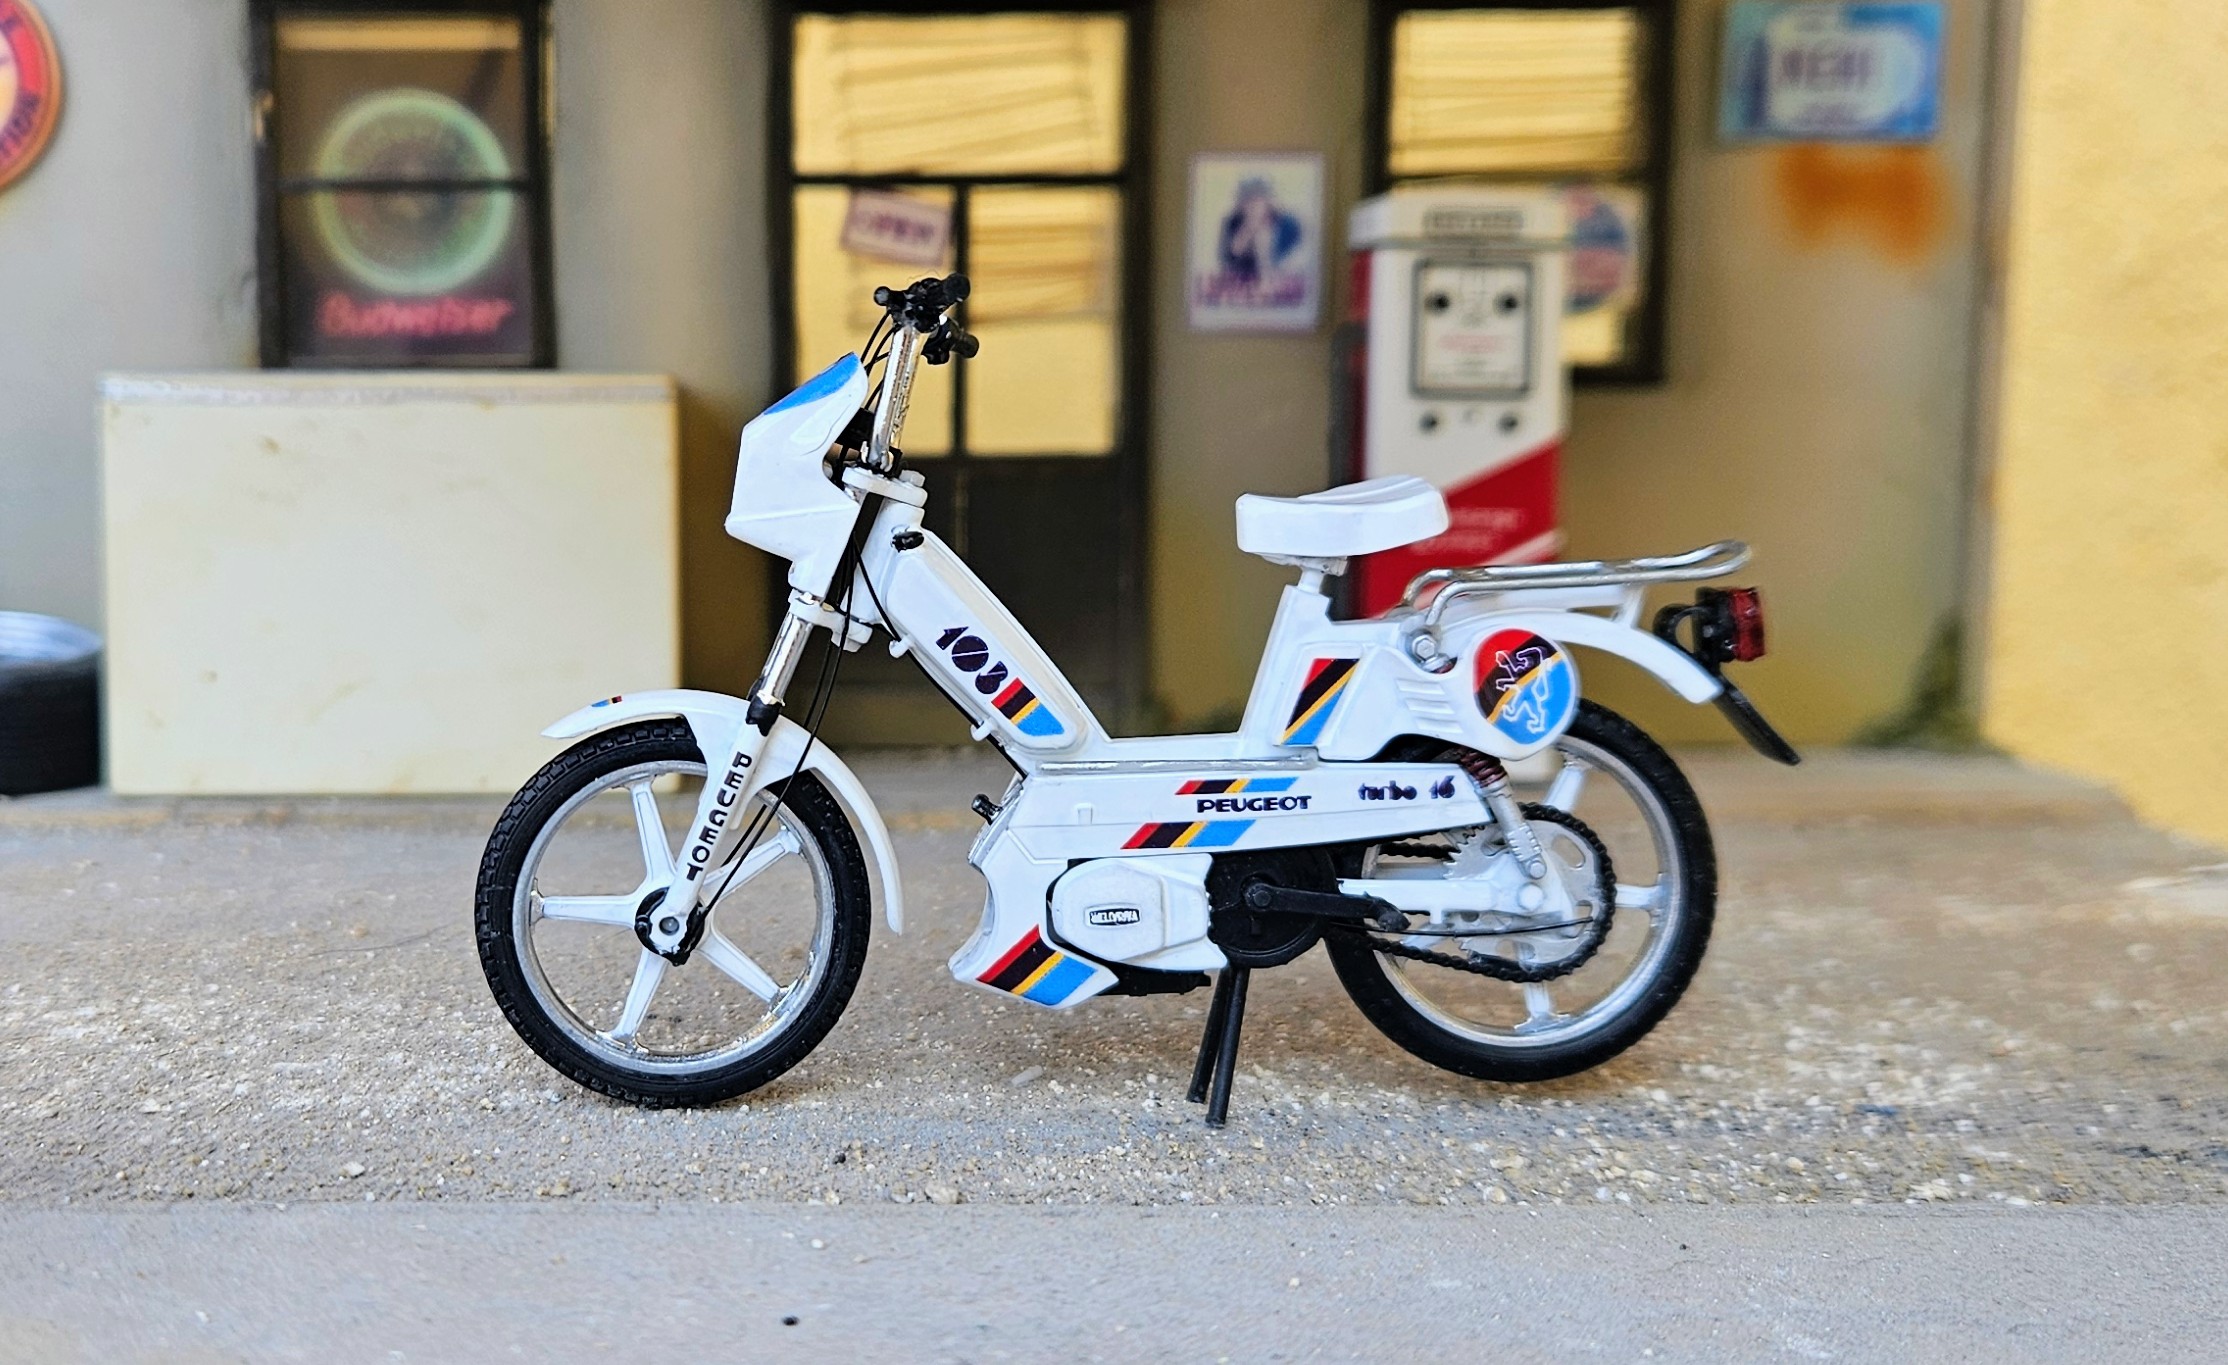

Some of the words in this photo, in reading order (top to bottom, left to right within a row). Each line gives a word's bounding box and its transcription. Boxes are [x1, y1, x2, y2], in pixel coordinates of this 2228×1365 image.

[936, 626, 1009, 694] 103
[686, 751, 753, 882] PEUGEOT
[1196, 795, 1312, 813] PEUGEOT
